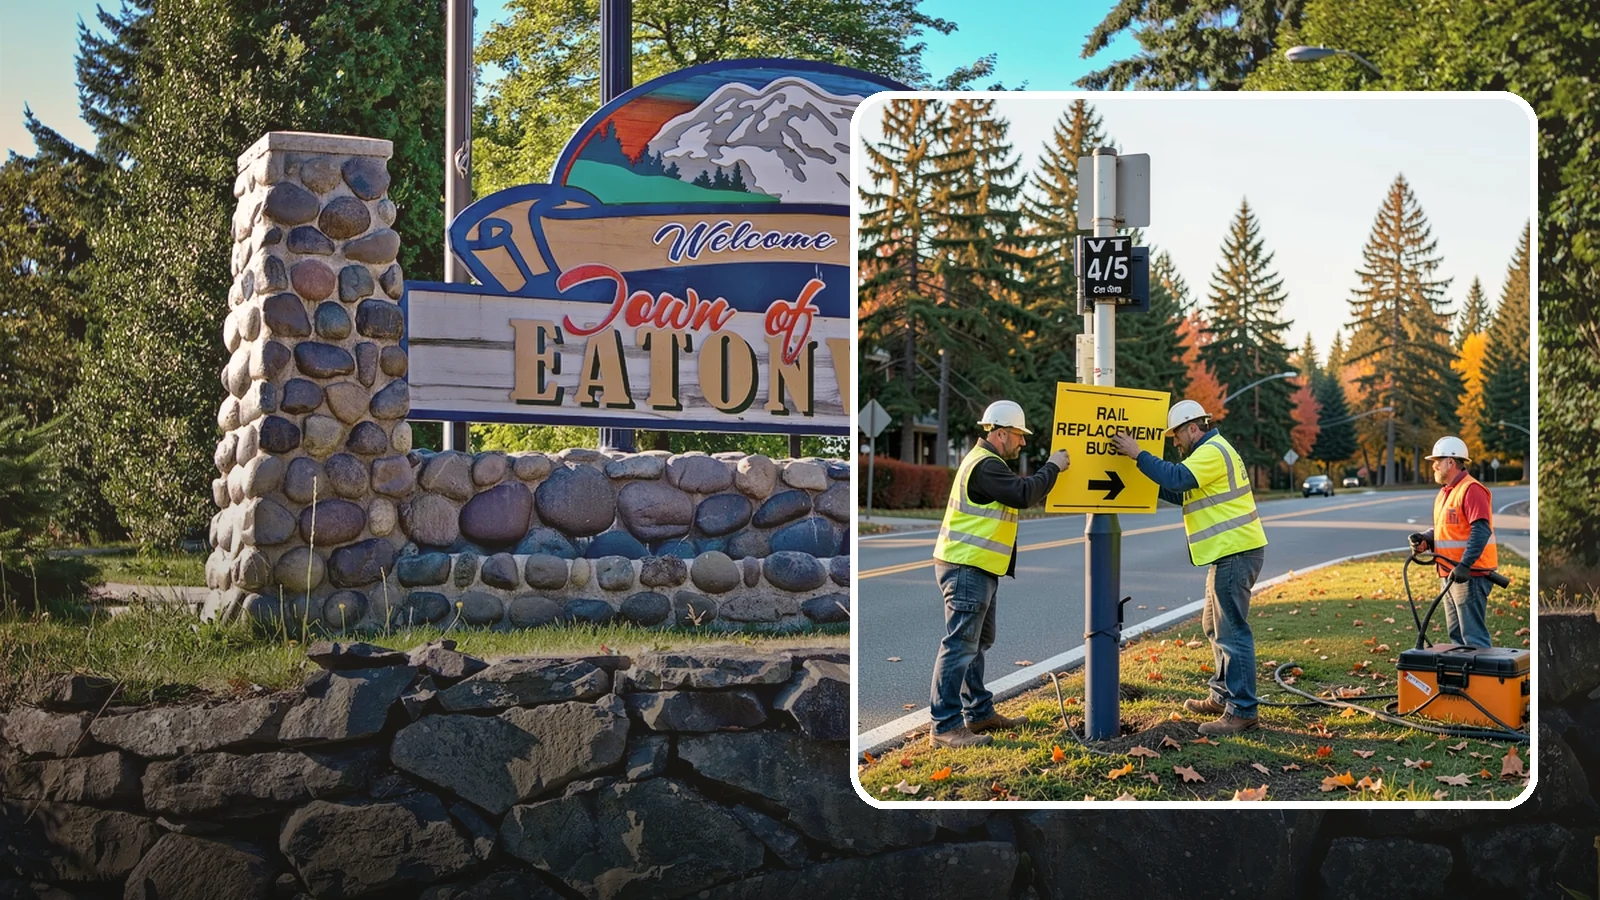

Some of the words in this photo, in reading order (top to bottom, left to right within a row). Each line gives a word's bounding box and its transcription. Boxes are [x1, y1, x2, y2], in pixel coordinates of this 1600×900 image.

[653, 220, 837, 263] Welcome
[1087, 256, 1128, 281] 4/5
[556, 263, 737, 336] Town
[765, 279, 826, 366] of
[1096, 406, 1129, 422] RAIL
[1056, 422, 1164, 441] REPLACEMENT
